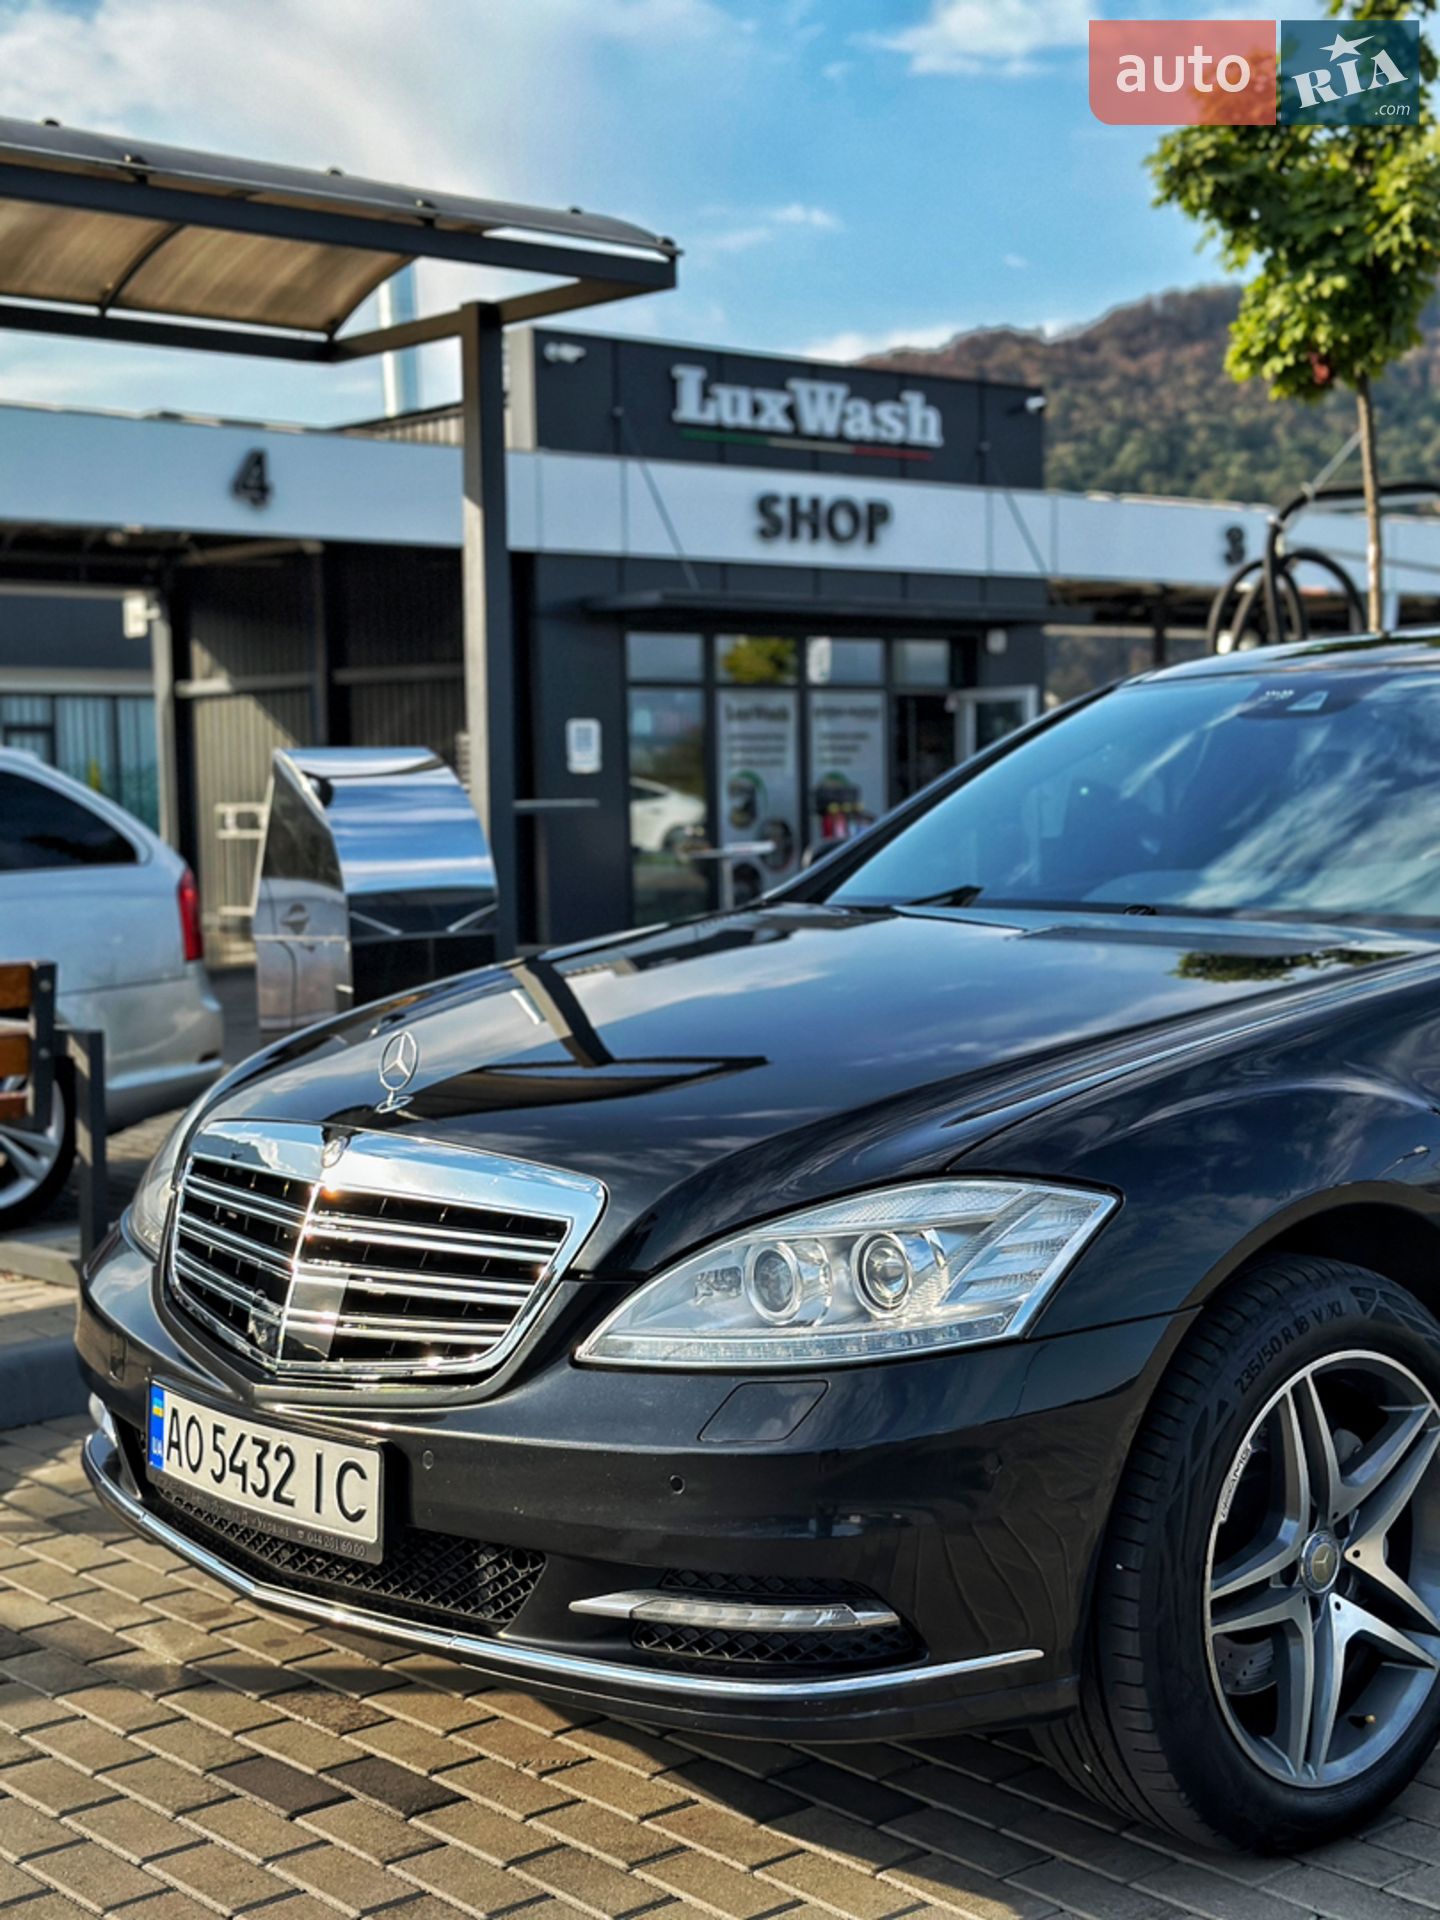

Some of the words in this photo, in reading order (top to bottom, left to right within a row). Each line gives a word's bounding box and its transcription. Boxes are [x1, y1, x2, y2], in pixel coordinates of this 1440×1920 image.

[672, 366, 943, 446] LuxWash
[231, 449, 272, 509] 4
[756, 493, 891, 544] SHOP
[1234, 1336, 1283, 1394] 235/50
[1281, 1326, 1295, 1344] R
[1294, 1315, 1310, 1335] 18
[210, 1422, 296, 1507] 5432
[314, 1450, 368, 1523] IC
